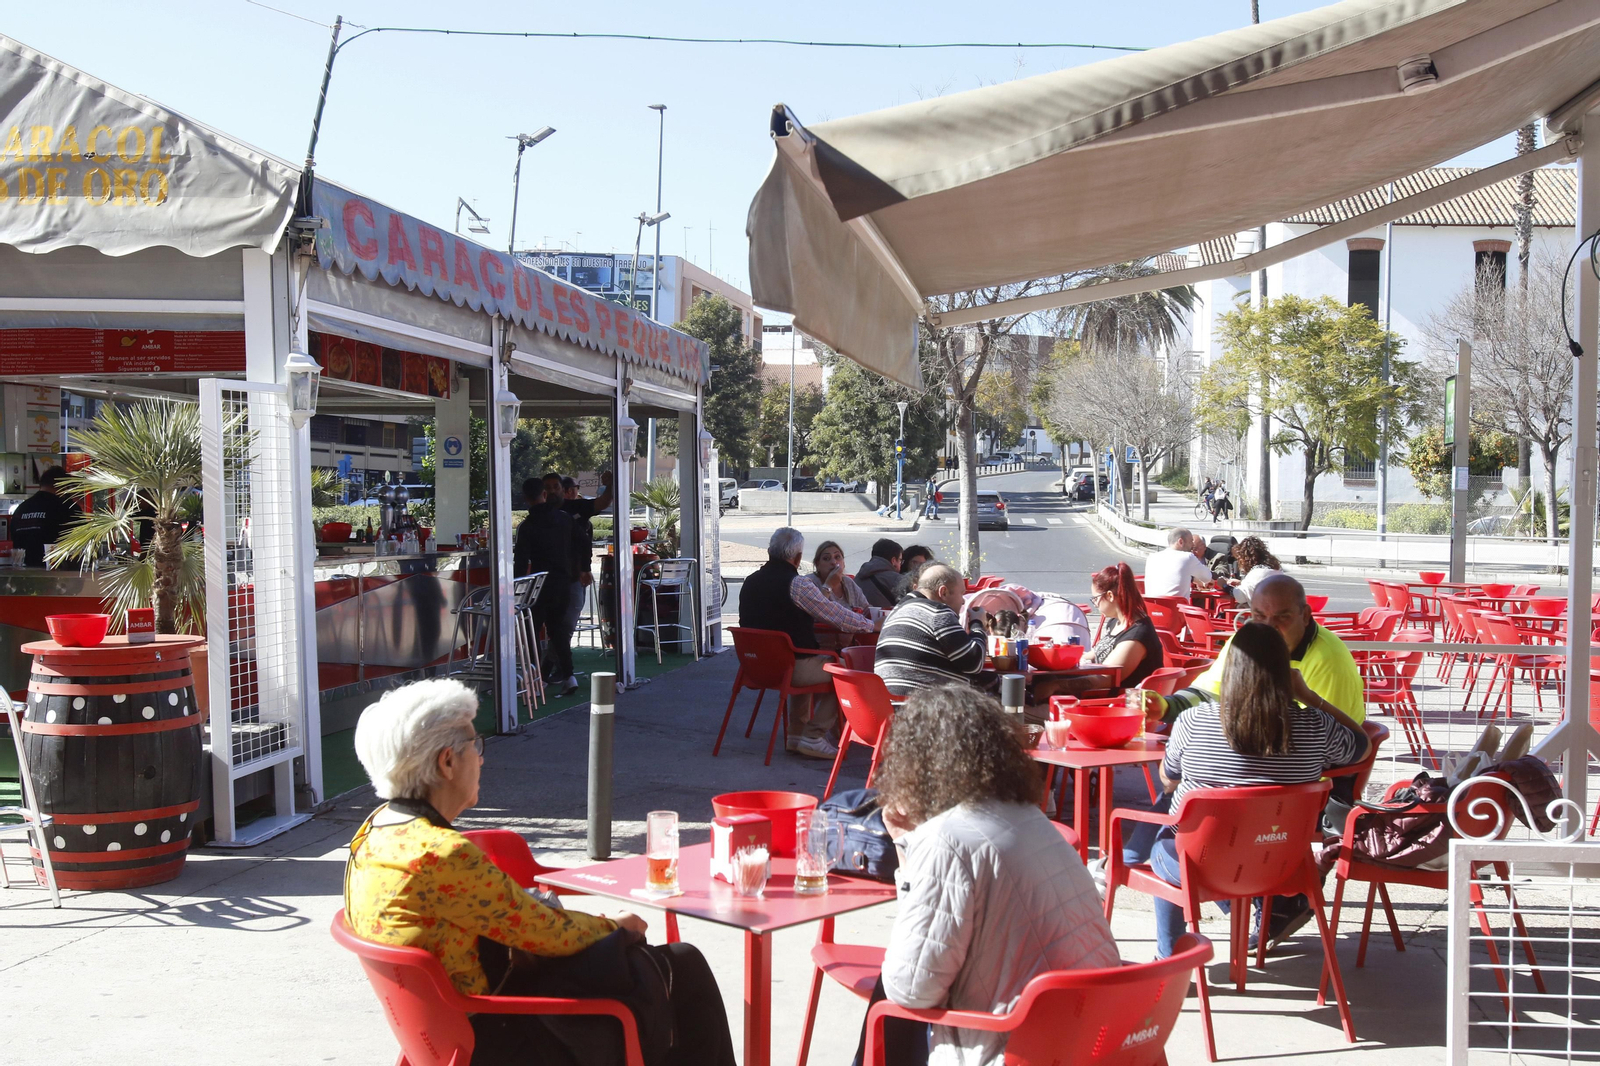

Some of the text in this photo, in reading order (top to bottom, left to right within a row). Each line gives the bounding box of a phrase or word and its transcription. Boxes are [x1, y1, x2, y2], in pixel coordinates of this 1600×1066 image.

[17, 167, 169, 207] DE ORO
[572, 258, 582, 268] EN
[582, 258, 613, 268] NUESTRO
[615, 259, 647, 269] TRABJO
[343, 198, 590, 333] CARACOLES
[595, 301, 671, 363] PEQUE
[130, 621, 153, 629] AMBAR
[1254, 831, 1288, 843] AMBAR
[1122, 1024, 1159, 1047] AMBAR
